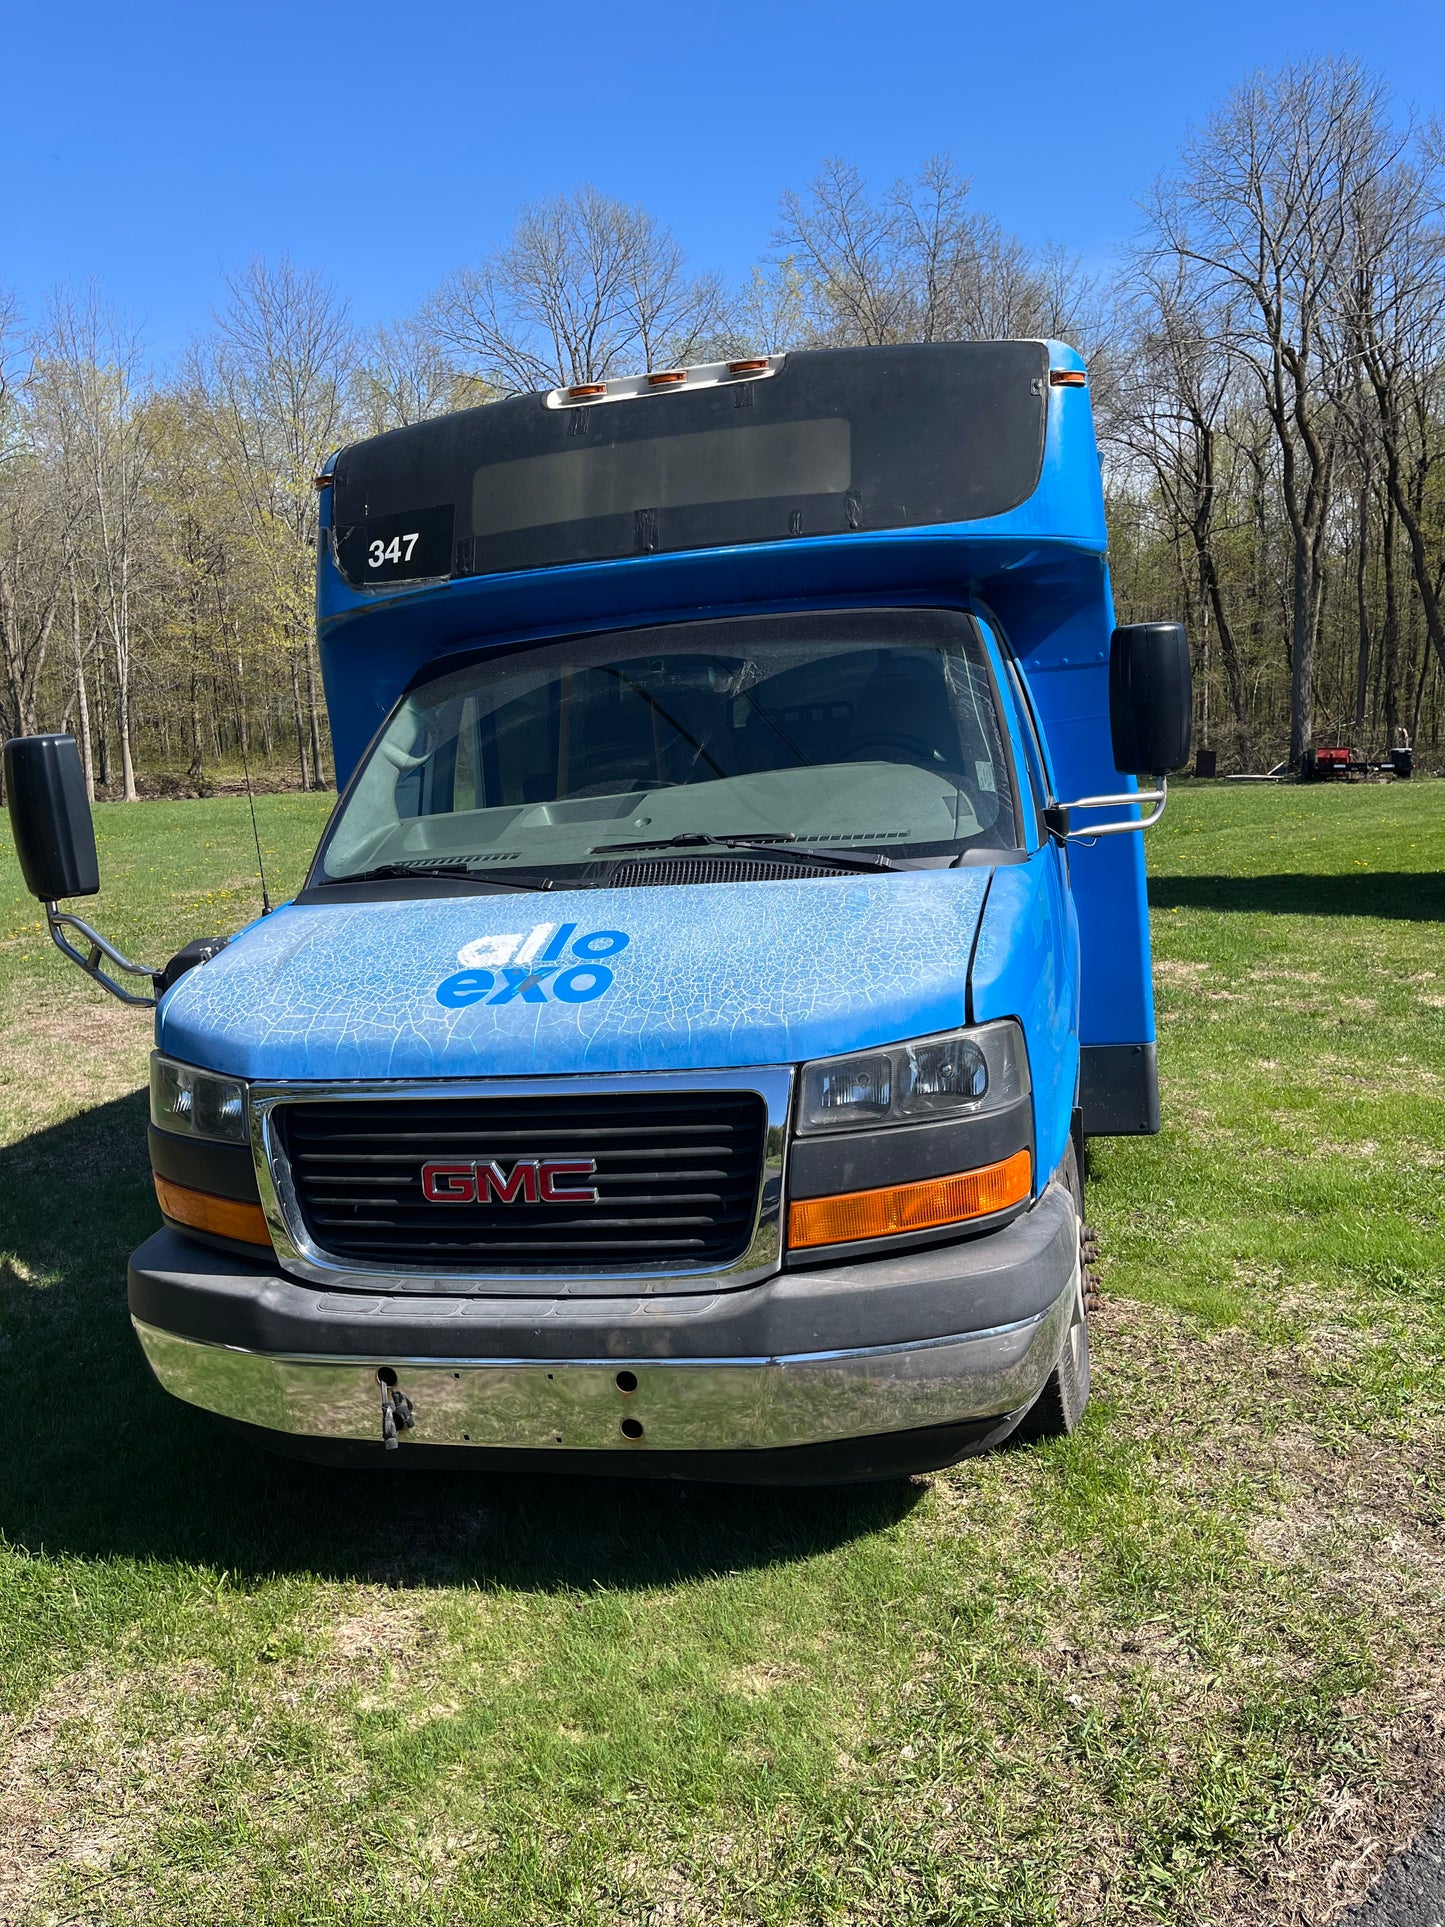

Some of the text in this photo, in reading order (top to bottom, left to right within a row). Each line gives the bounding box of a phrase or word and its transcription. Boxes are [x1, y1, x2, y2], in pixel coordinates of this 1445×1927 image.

[368, 532, 419, 568] 347
[457, 922, 631, 967] allo
[435, 963, 614, 1009] exo
[421, 1157, 600, 1204] GMC
